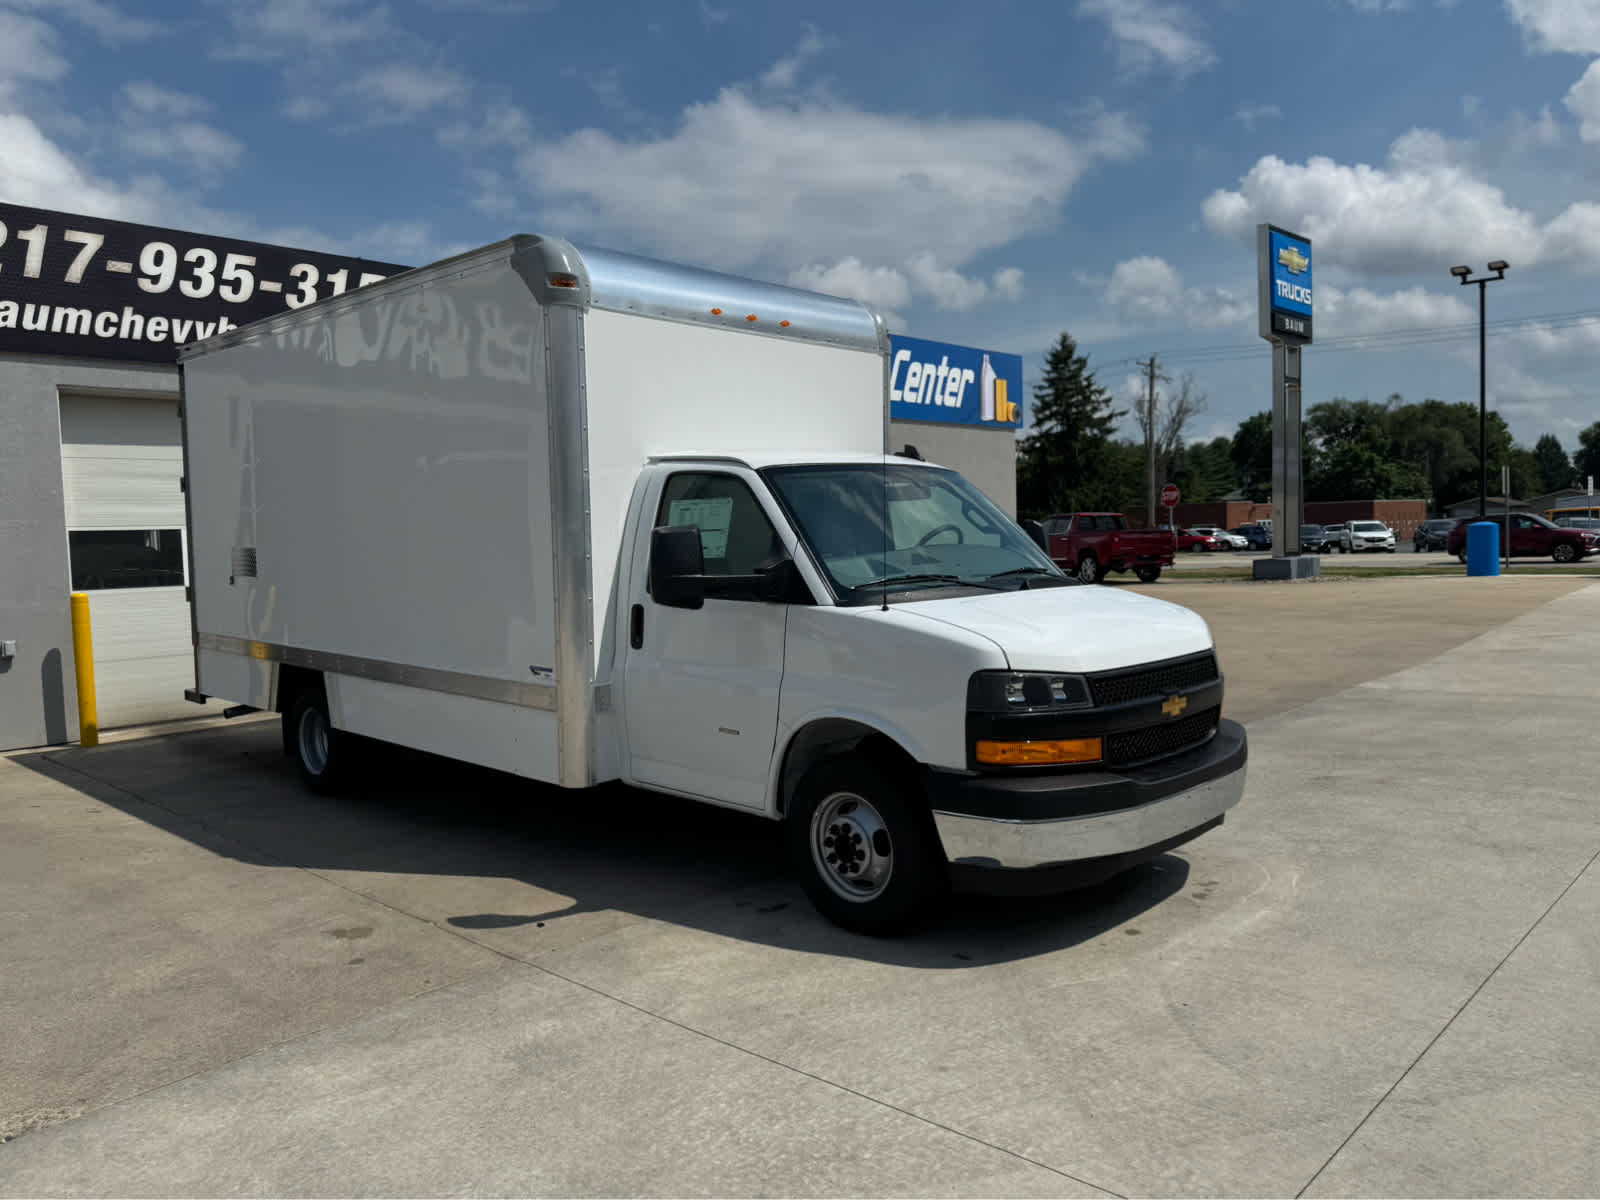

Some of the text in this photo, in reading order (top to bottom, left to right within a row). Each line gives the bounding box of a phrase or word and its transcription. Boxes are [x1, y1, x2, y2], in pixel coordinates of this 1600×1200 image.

[1275, 279, 1312, 305] TRUCKS
[1285, 318, 1304, 332] BAUM
[890, 349, 975, 408] Center
